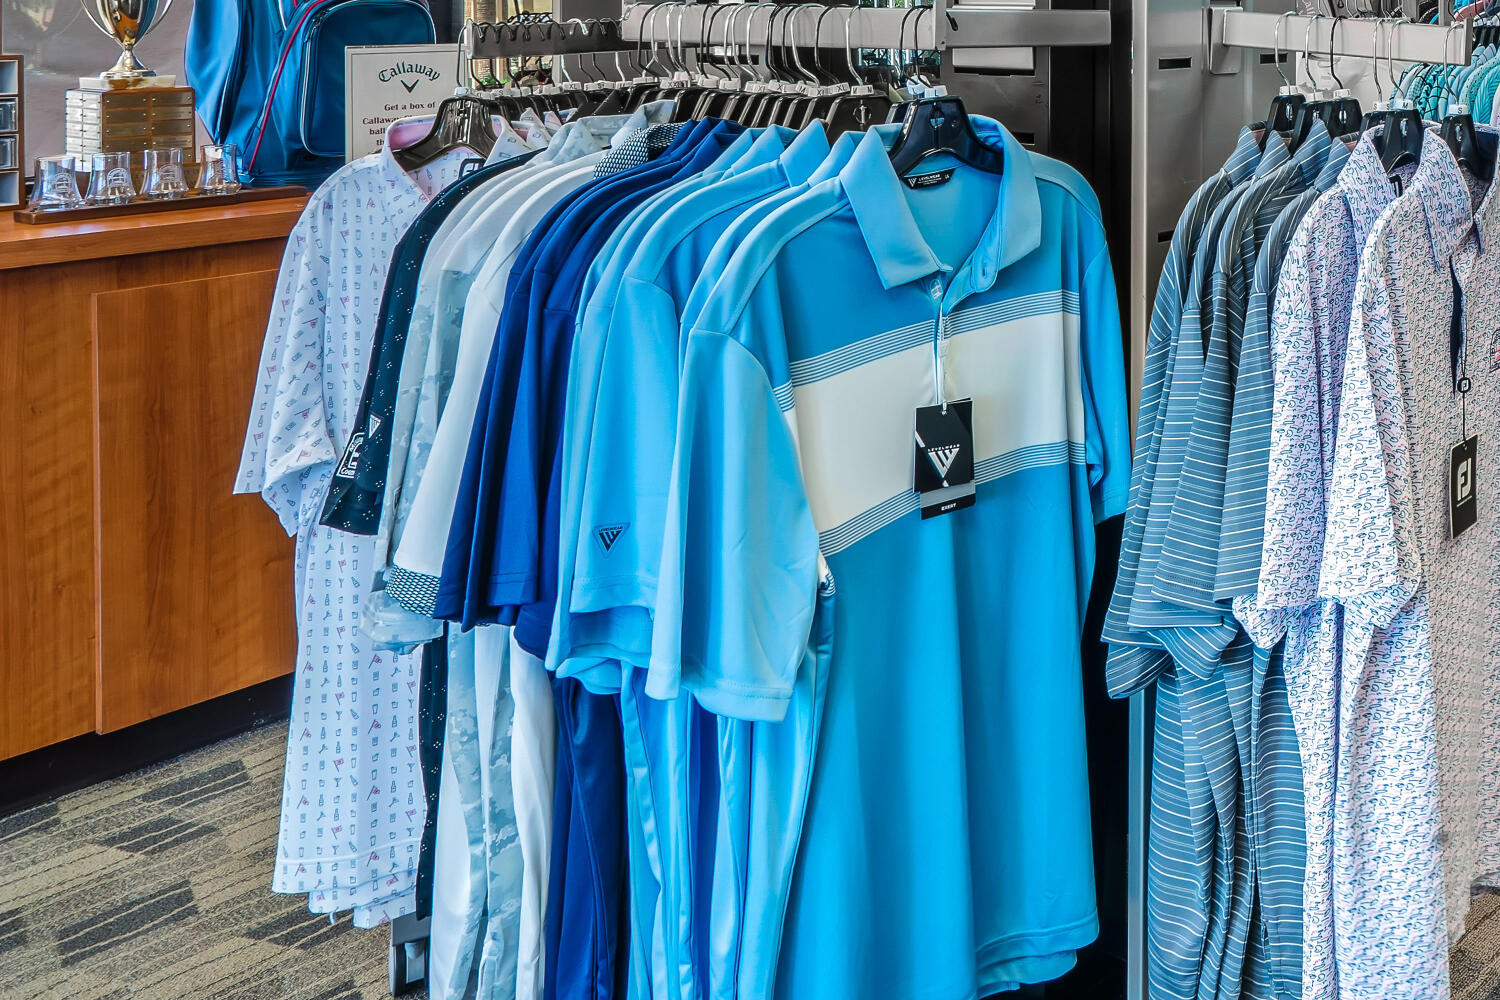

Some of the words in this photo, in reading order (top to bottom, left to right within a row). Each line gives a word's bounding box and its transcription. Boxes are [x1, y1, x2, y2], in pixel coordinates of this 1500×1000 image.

[378, 60, 441, 82] Callaway
[384, 103, 399, 111] Get
[1457, 457, 1471, 501] FJ
